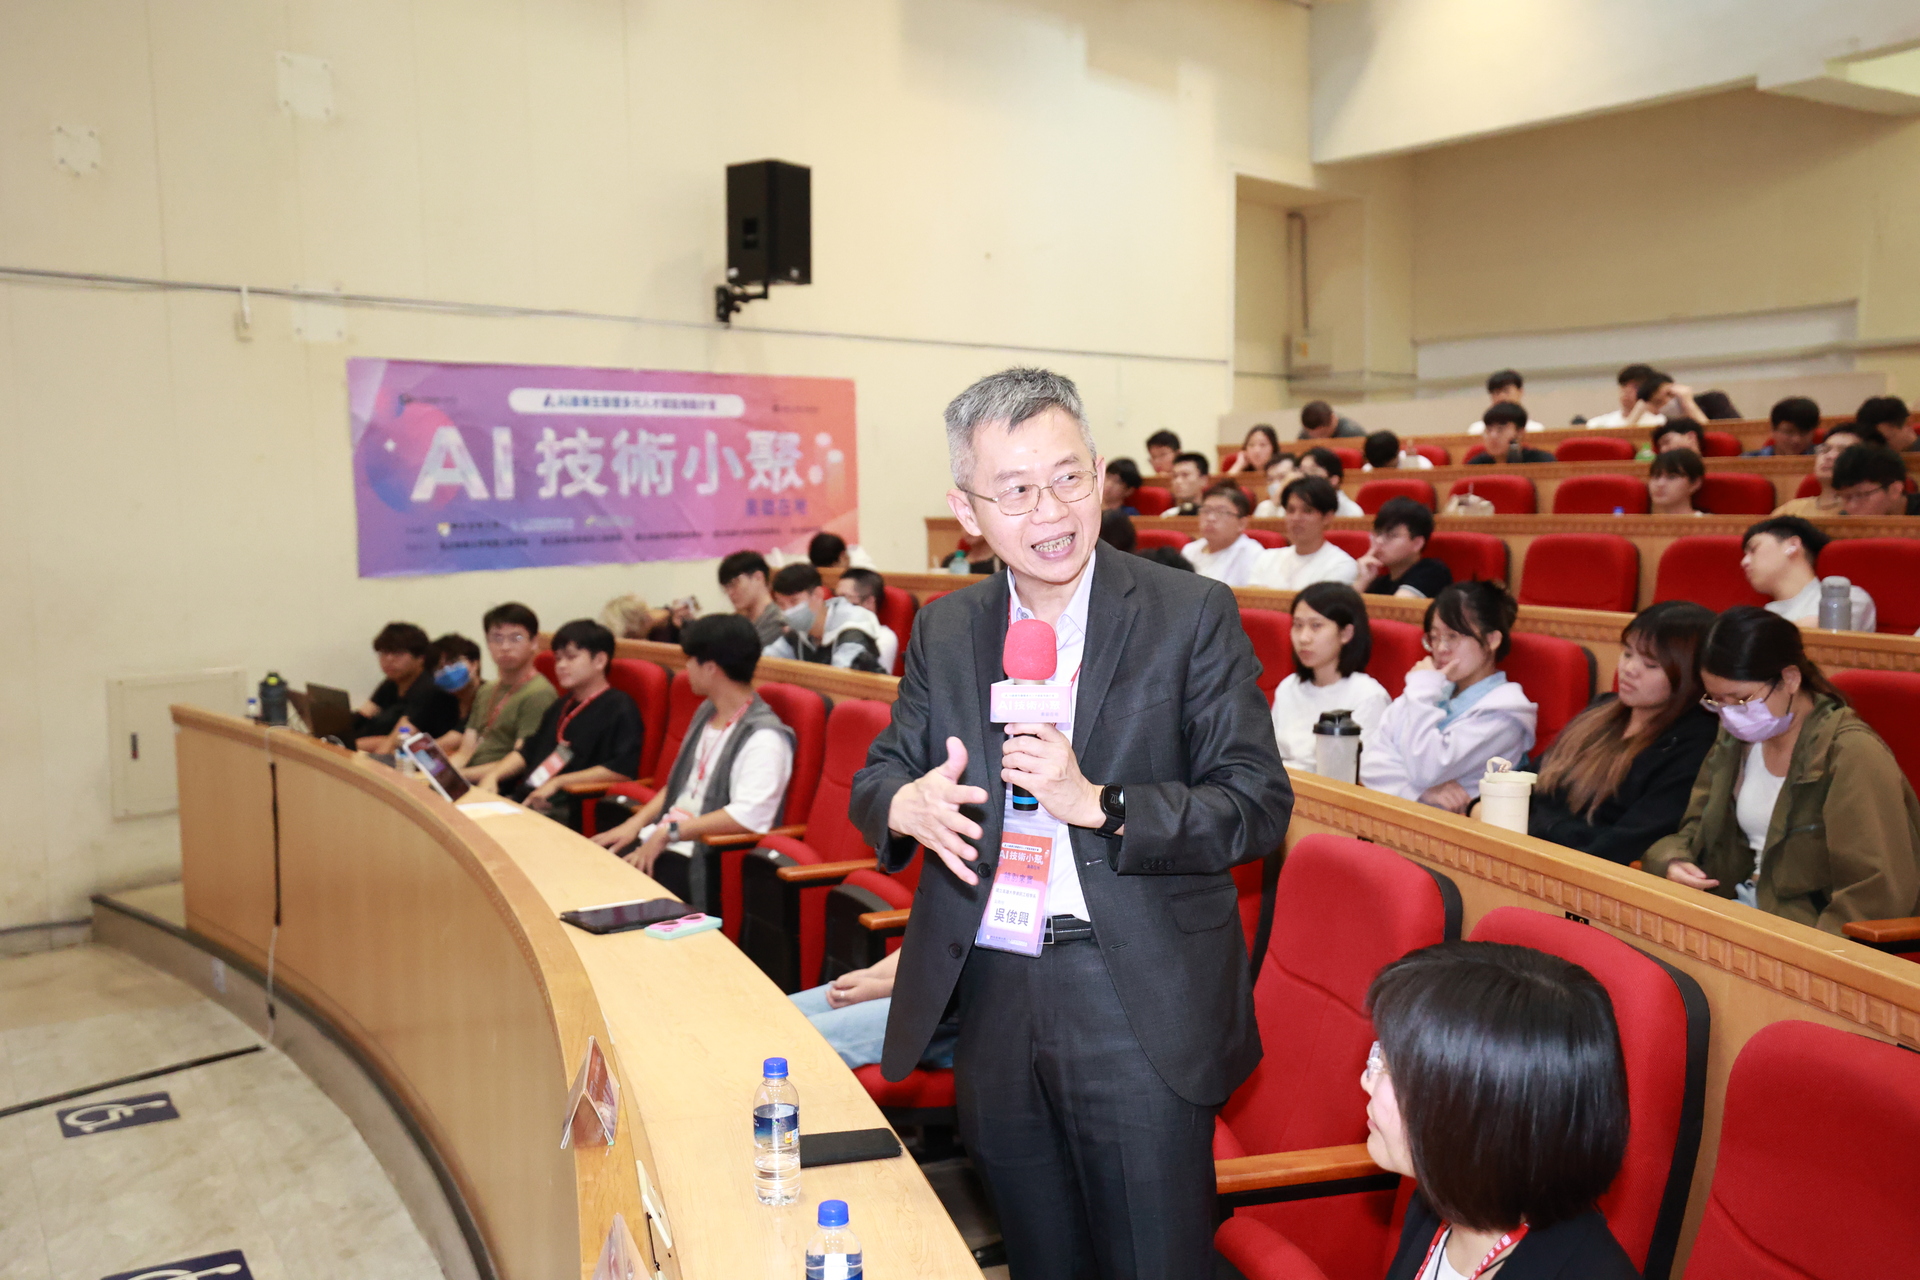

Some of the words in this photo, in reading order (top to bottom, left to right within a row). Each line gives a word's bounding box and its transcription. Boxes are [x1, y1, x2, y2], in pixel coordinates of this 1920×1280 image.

[410, 425, 515, 502] AI
[993, 907, 1030, 927] 吳俊興
